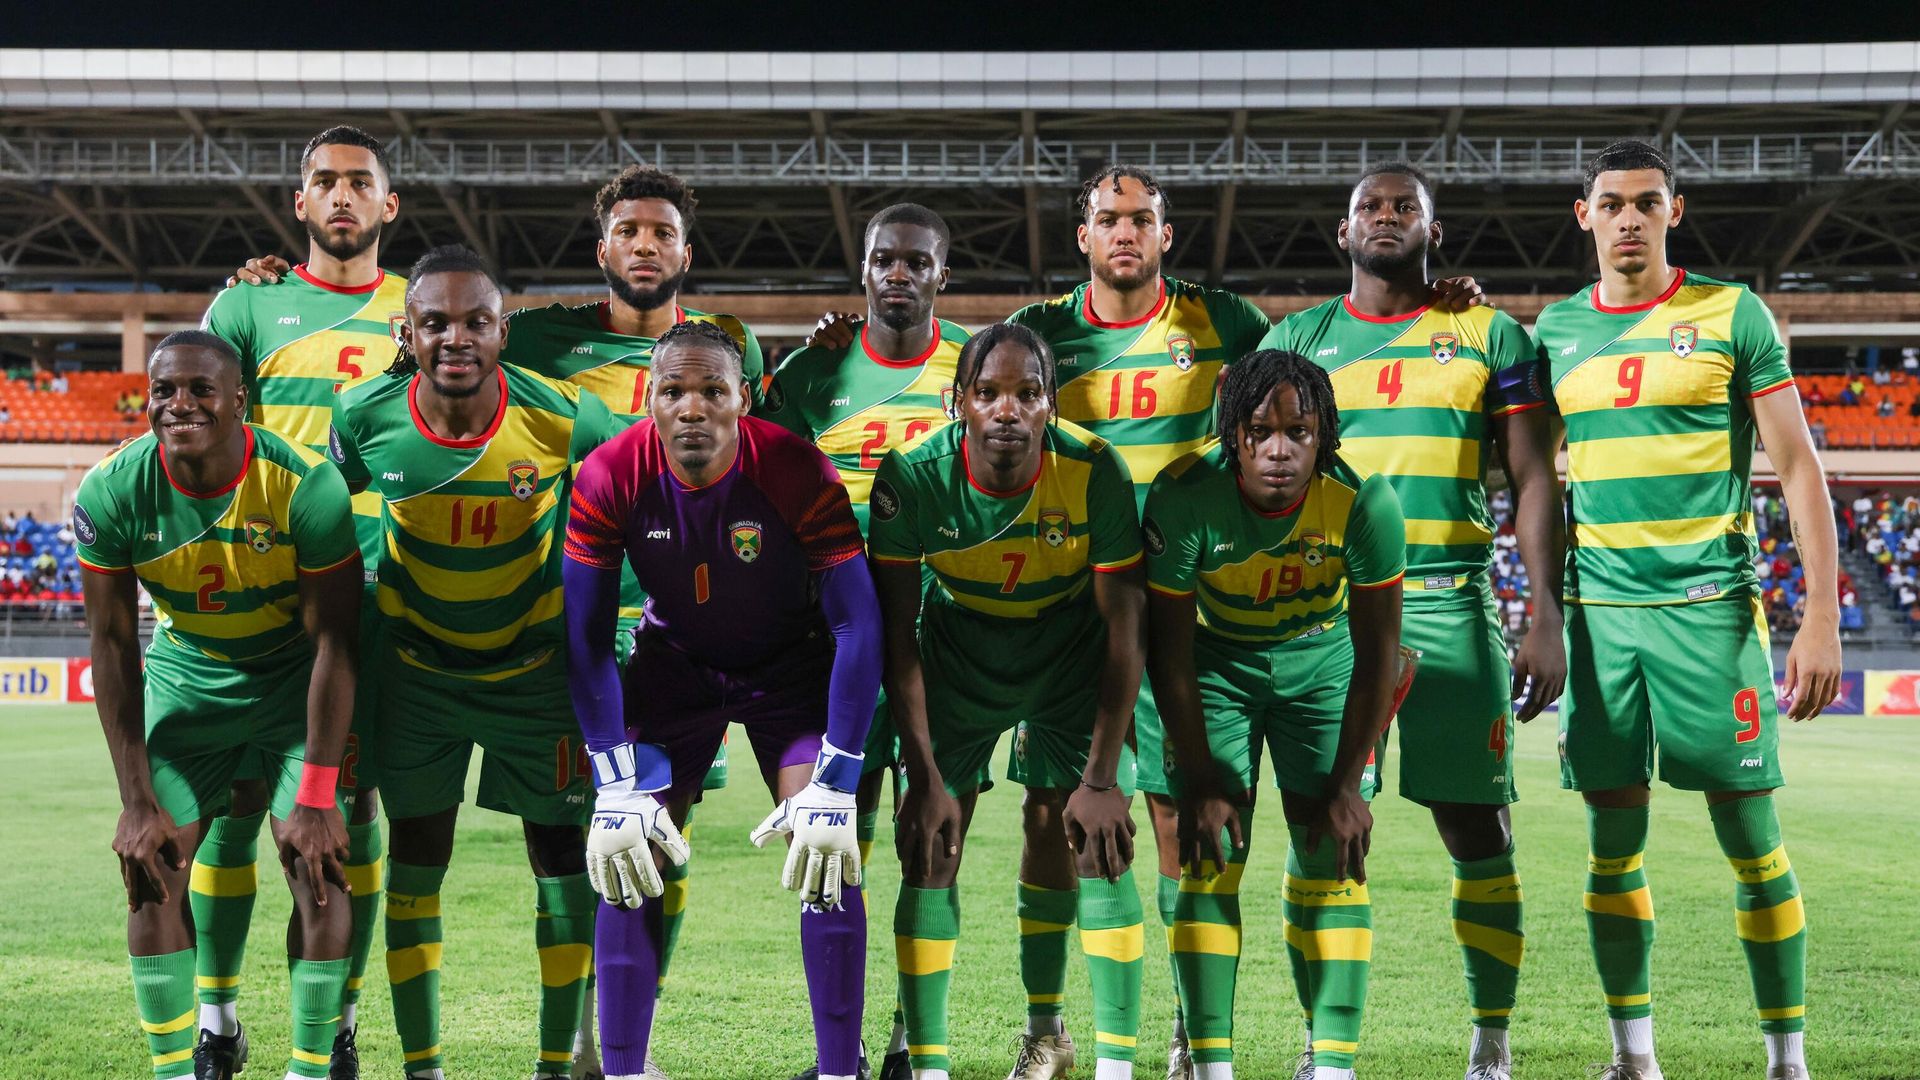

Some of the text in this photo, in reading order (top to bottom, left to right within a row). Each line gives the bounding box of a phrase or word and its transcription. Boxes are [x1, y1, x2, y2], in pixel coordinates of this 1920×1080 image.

[277, 315, 301, 325] savi
[333, 346, 365, 394] 5
[570, 345, 593, 355] savi
[1058, 355, 1077, 365] savi
[1316, 346, 1338, 357] savi
[830, 396, 850, 406] savi
[1109, 371, 1159, 419] 16
[1377, 358, 1404, 405] 4
[1614, 356, 1645, 408] 9
[382, 471, 404, 482] savi
[451, 498, 498, 545] 14
[647, 528, 671, 540] savi
[938, 526, 959, 539] savi
[197, 563, 227, 613] 2
[695, 563, 710, 604] 1
[1000, 551, 1028, 593] 7
[1253, 564, 1304, 605] 19
[1733, 687, 1761, 744] 9
[1488, 713, 1508, 763] 4
[1740, 756, 1763, 767] savi
[566, 794, 585, 804] savi
